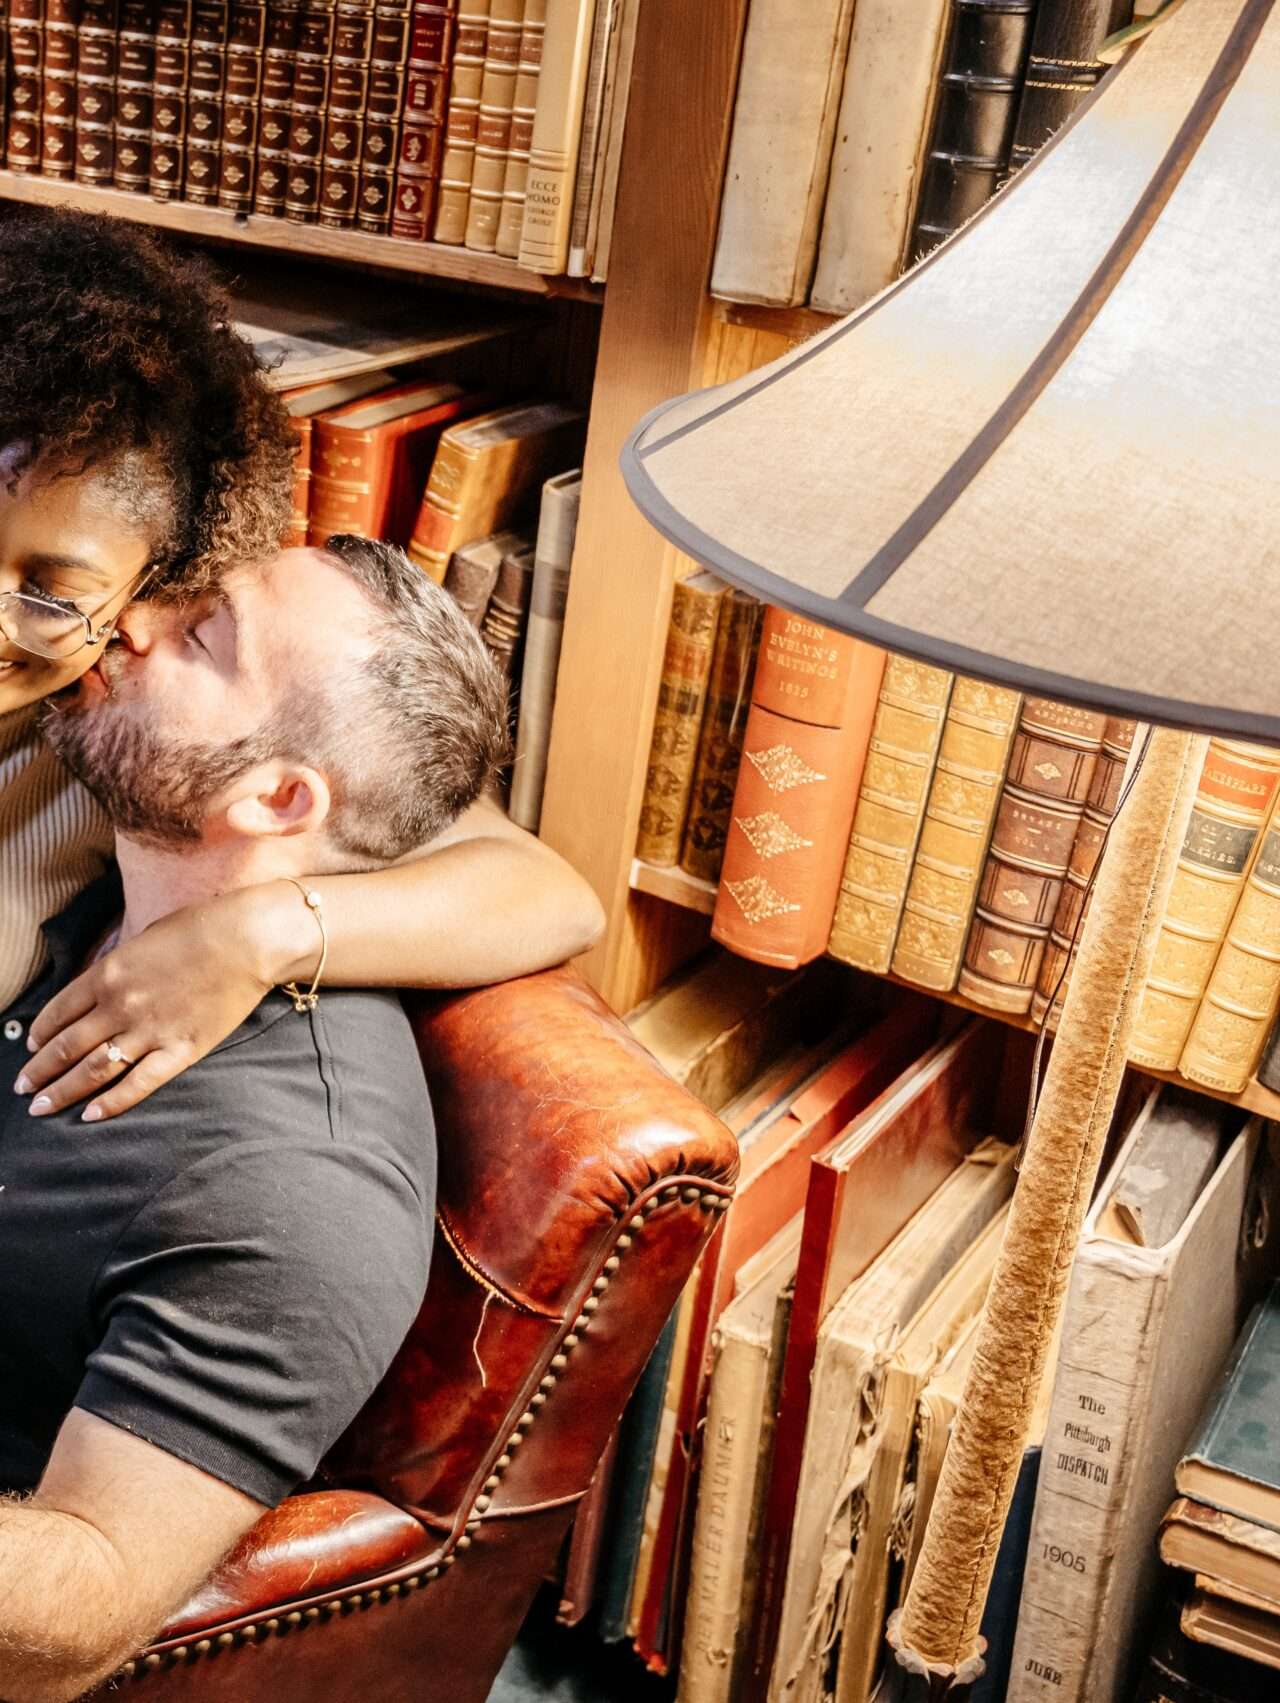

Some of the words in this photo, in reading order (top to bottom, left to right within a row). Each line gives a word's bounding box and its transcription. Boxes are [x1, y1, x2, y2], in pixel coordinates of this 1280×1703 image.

[527, 193, 561, 206] HOMO
[530, 180, 558, 193] ECCE
[784, 619, 825, 641] JOHN
[769, 631, 838, 663] EVELYN'S
[765, 648, 839, 680] WRITINGS
[1079, 1394, 1107, 1416] The
[1063, 1421, 1112, 1454] Pittsburgh
[1056, 1452, 1110, 1486] DISPATCH
[1042, 1543, 1087, 1574] 1905
[1024, 1657, 1063, 1687] JUNE
